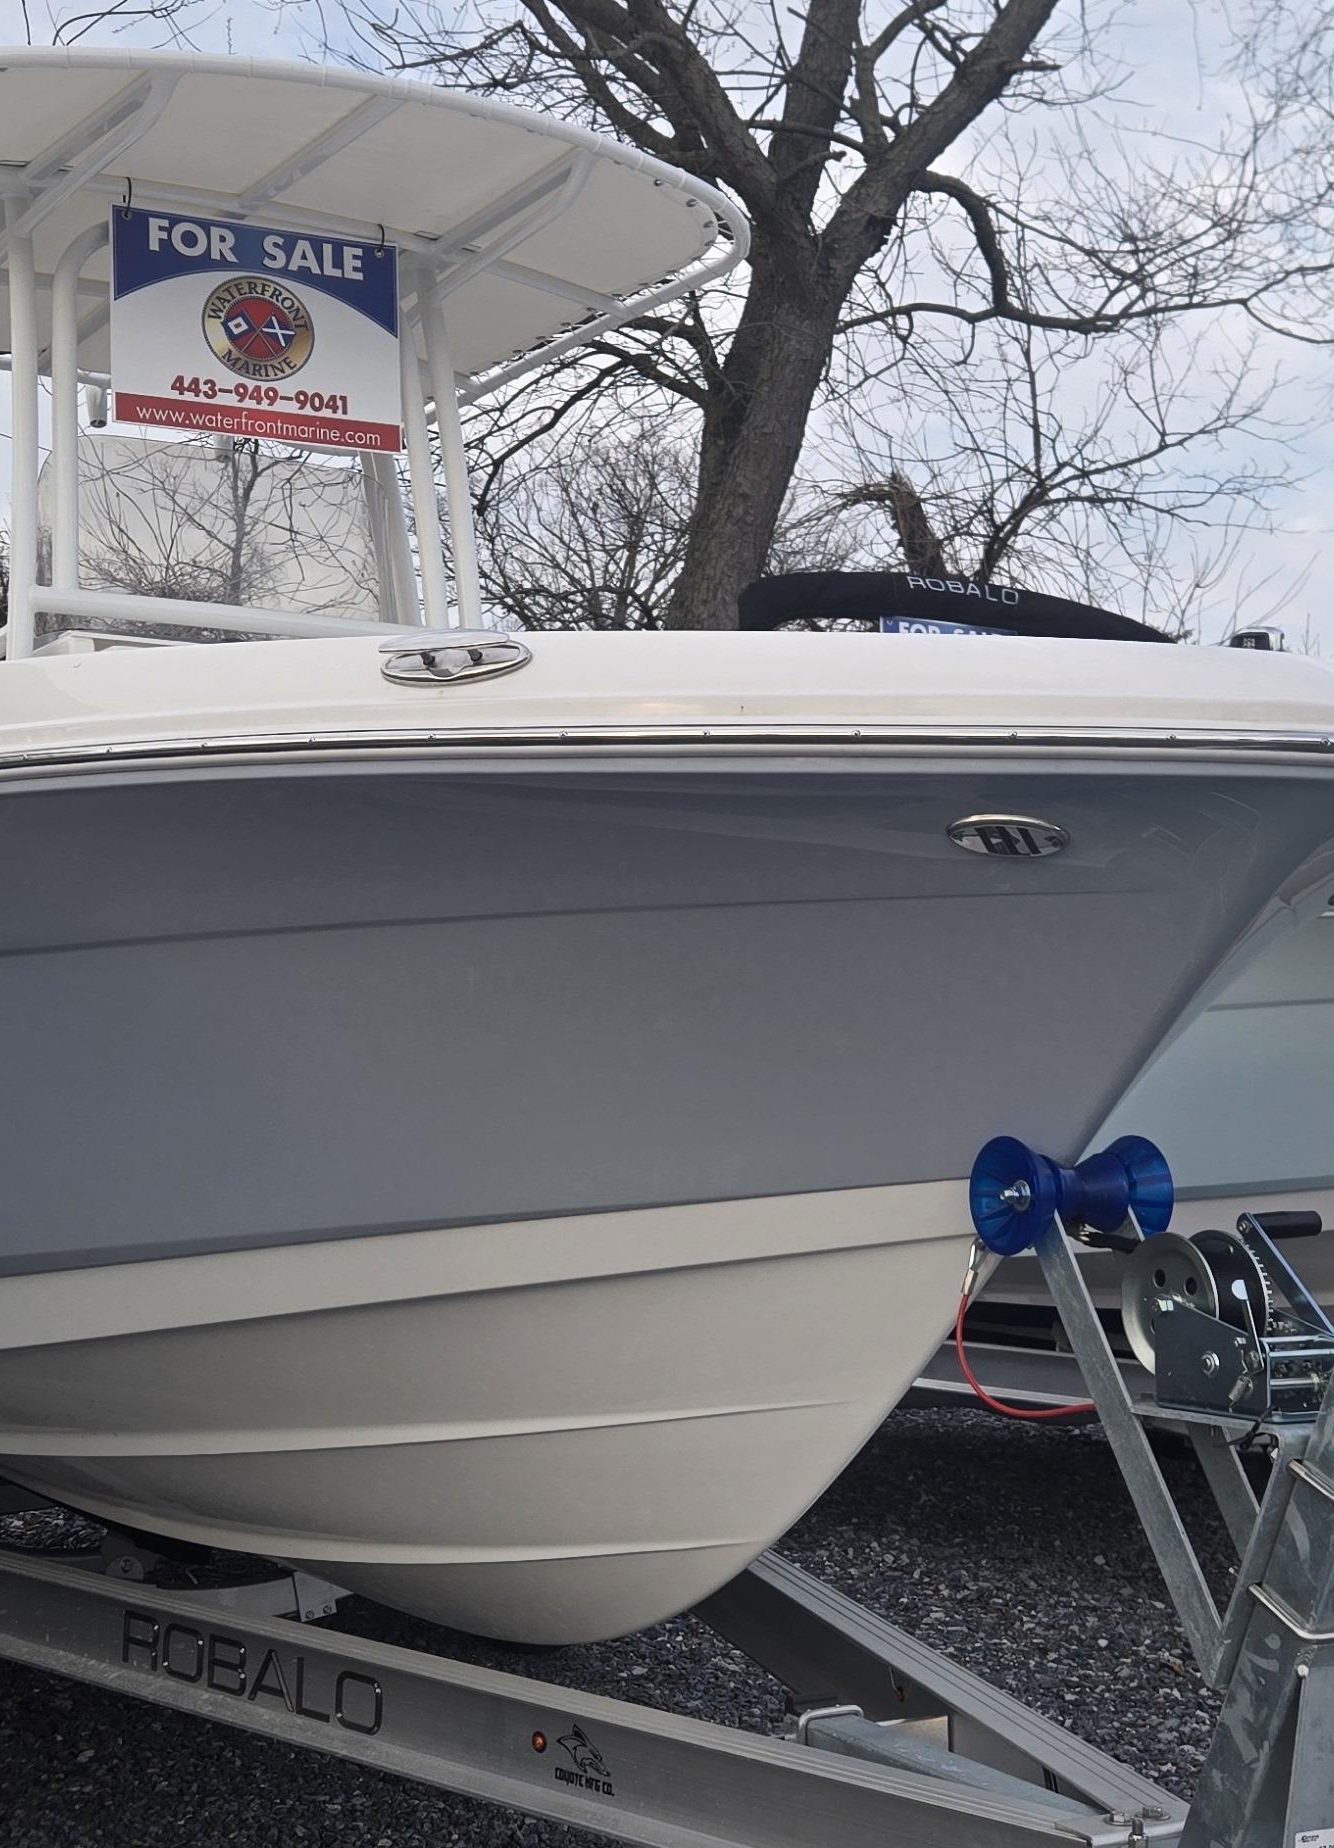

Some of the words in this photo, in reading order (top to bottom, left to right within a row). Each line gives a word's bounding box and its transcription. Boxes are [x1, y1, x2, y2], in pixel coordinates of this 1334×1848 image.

[148, 217, 239, 263] FOR
[262, 234, 364, 281] SALE
[207, 281, 309, 332] WATERFRONT
[221, 348, 297, 378] MARINE
[170, 375, 348, 415] 443-949-9041
[136, 404, 381, 446] www.waterfrontmarine.com
[906, 575, 1019, 605] ROBALO
[121, 1609, 384, 1736] ROBALO
[555, 1766, 584, 1788] COYOTE
[602, 1781, 615, 1797] CO.
